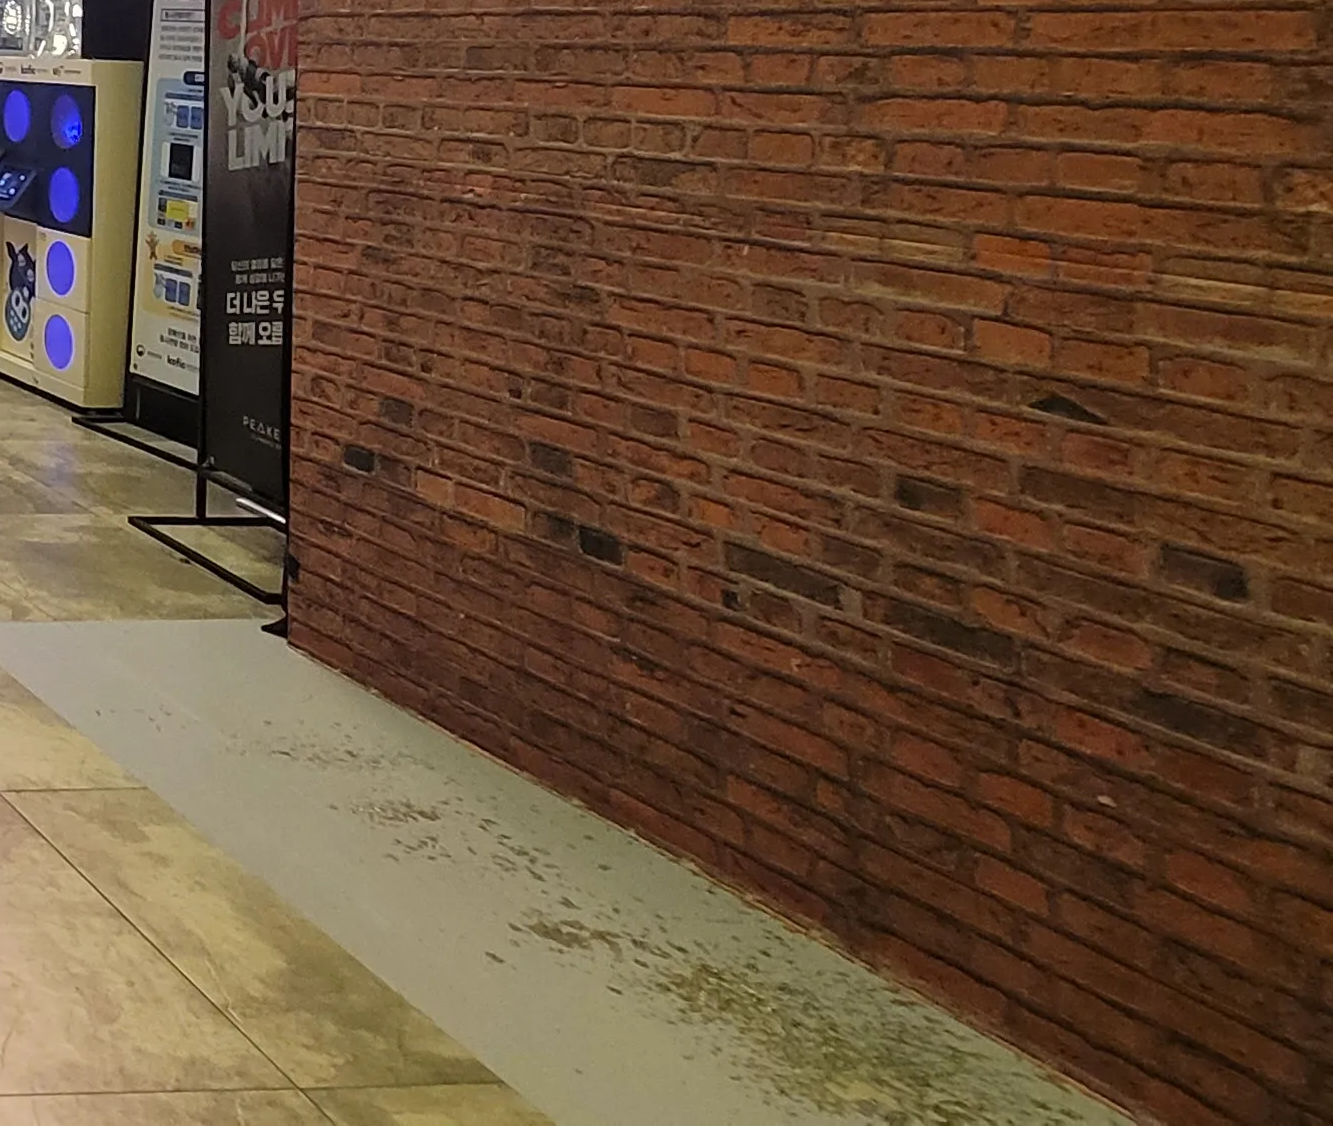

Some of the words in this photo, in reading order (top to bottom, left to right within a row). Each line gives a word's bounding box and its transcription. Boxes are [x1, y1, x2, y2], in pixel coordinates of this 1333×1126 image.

[227, 116, 293, 171] LIMI
[226, 291, 241, 314] 더
[243, 290, 270, 314] 나은
[228, 321, 256, 345] 함께
